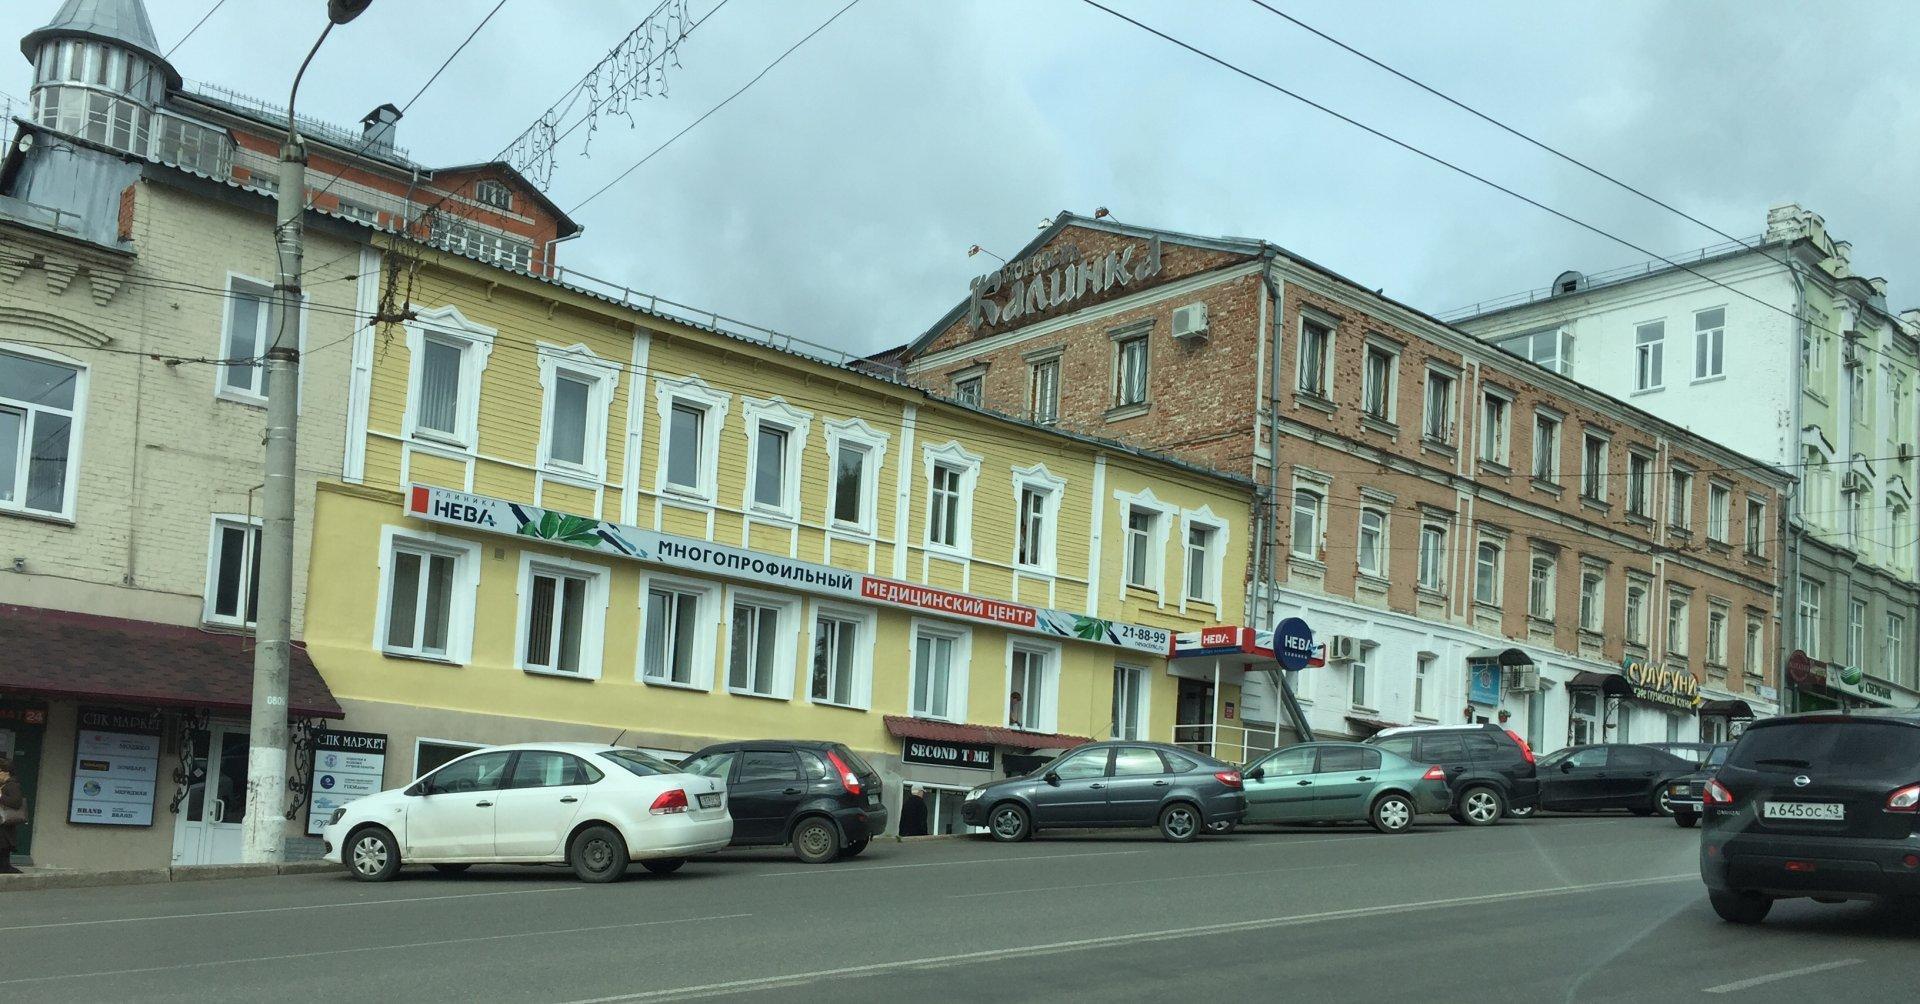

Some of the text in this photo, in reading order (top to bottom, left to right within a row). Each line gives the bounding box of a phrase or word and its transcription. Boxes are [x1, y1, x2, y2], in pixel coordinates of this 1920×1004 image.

[435, 490, 496, 508] КЛИНИКА
[434, 499, 497, 527] НЕВА
[658, 540, 1033, 624] МНОГОПРОФИЛЬНЫЙ МЕДИЦИНСКИЙ ЦЕНТР
[1122, 625, 1166, 644] 21-88-99
[1203, 634, 1229, 644] НЕВА
[1284, 635, 1312, 651] НЕВА
[1865, 682, 1892, 700] СБЕРБАНК
[317, 734, 386, 749] СПК МАРКЕТ
[910, 743, 958, 761] SECOND
[77, 807, 102, 815] BRAND
[1826, 804, 1839, 815] 43
